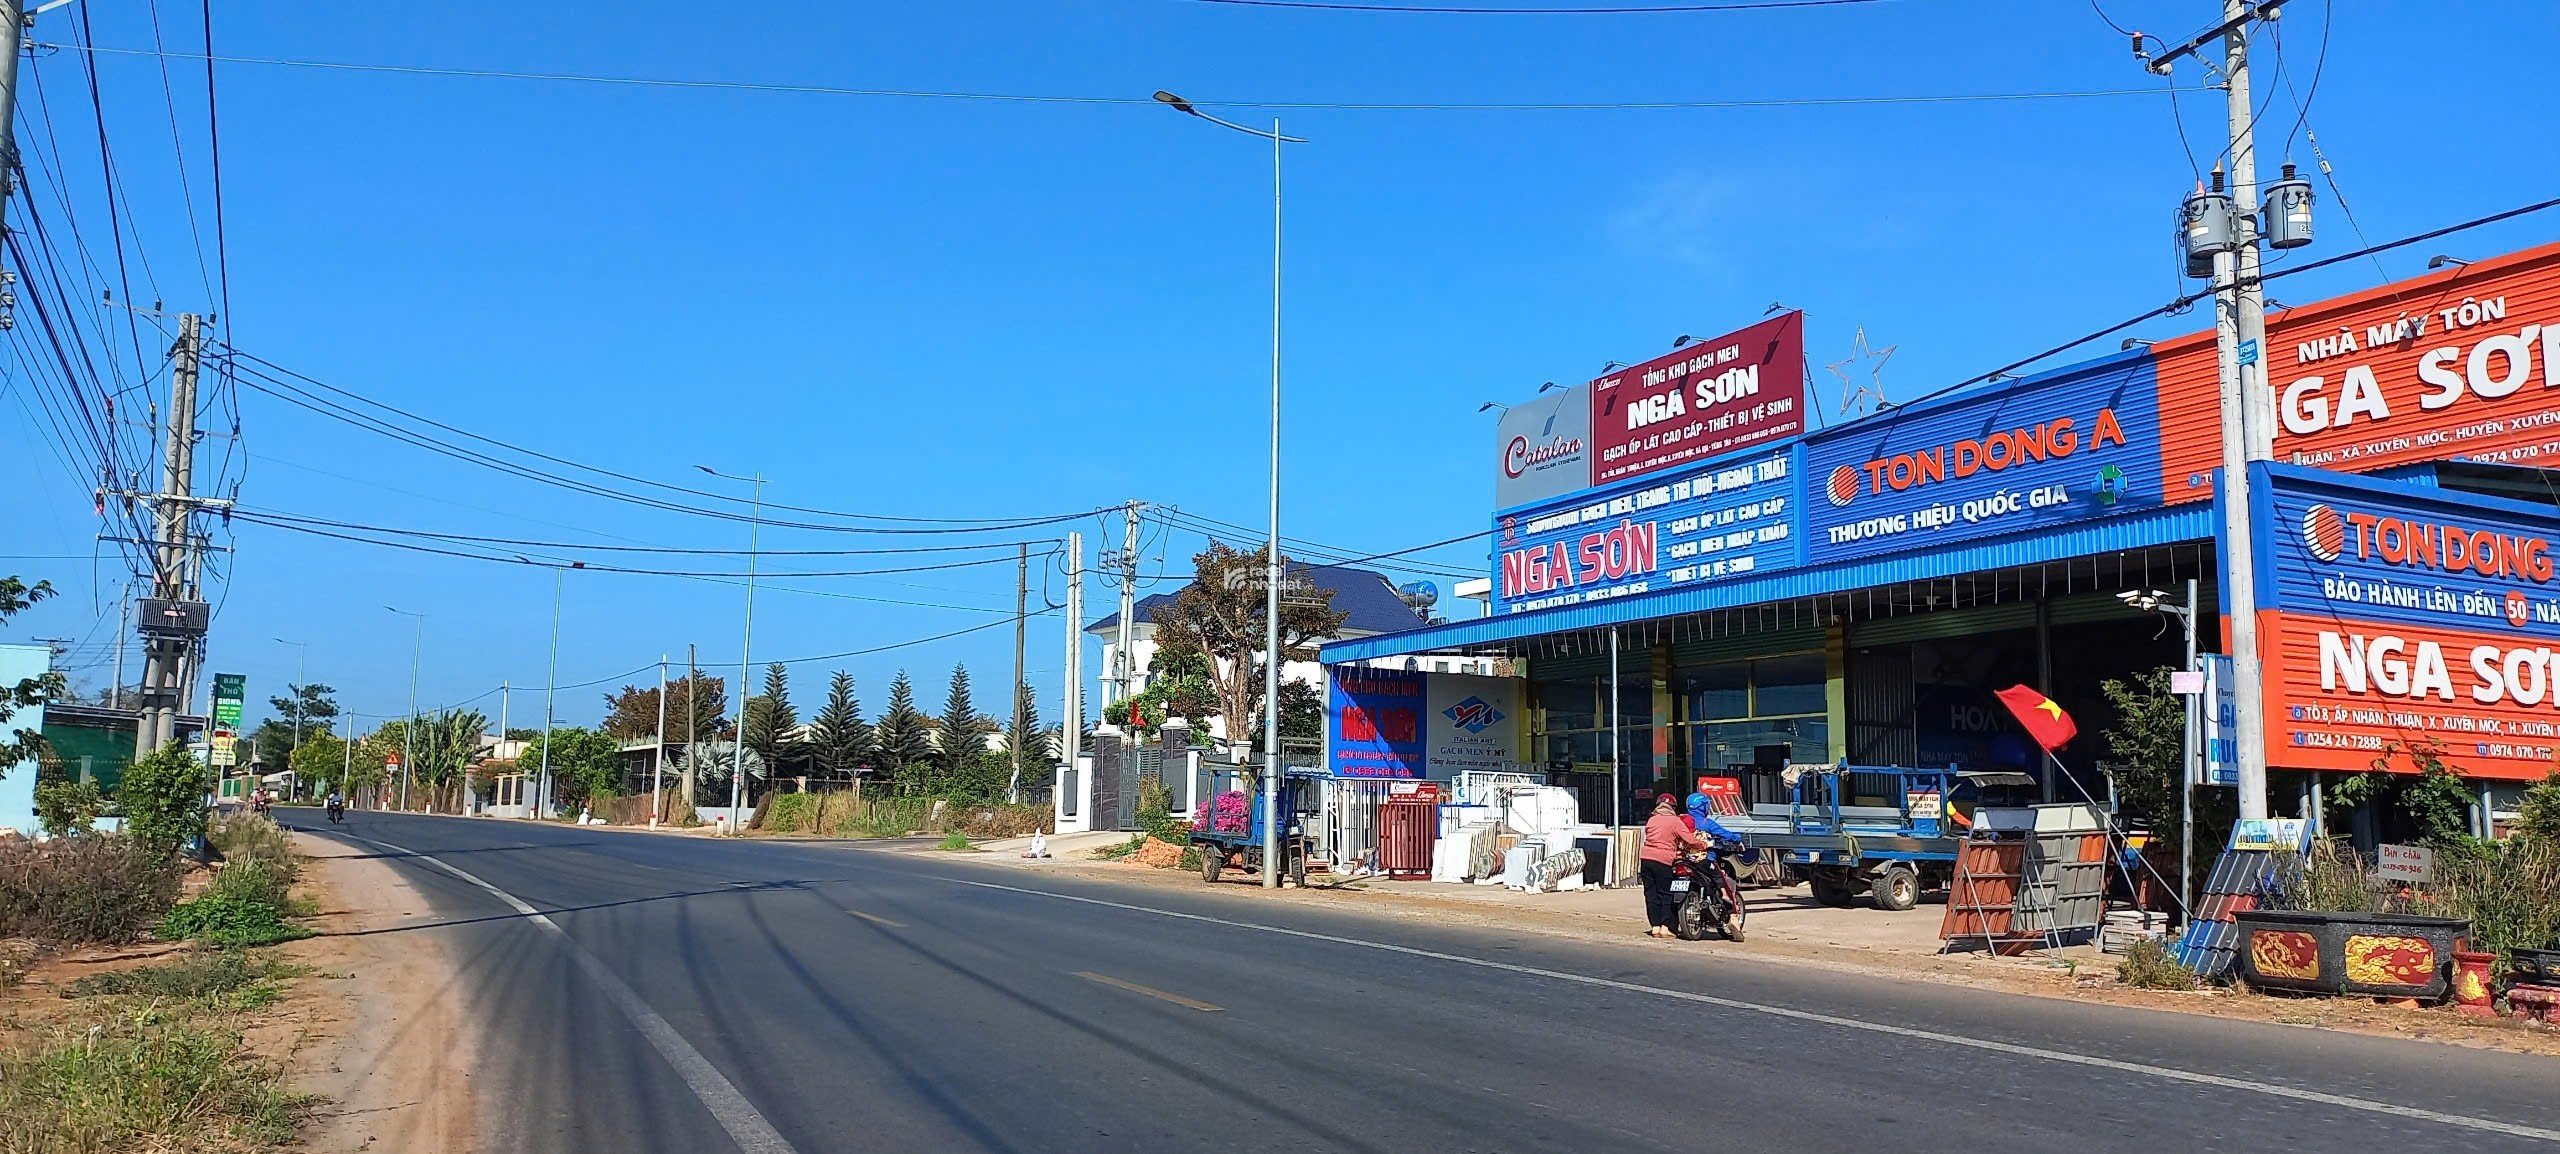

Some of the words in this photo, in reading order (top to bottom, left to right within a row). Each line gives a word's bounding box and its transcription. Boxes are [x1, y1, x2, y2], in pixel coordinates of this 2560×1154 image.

[2298, 326, 2358, 363] NHÀ
[2367, 312, 2428, 348] MÁY
[2439, 296, 2506, 331] TÔN
[1642, 366, 1666, 389] TỔNG
[1668, 361, 1687, 381] KHO
[1689, 351, 1714, 373] GẠCH
[1717, 343, 1739, 365] MEN
[1627, 388, 1686, 431] NGA
[1695, 363, 1759, 410] SƠN
[1603, 443, 1627, 463] GẠCH
[1628, 437, 1642, 456] ỐP
[1643, 433, 1660, 452] LÁT
[1662, 428, 1681, 445] CAO
[1738, 410, 1749, 426] BỊ
[1751, 402, 1765, 422] VỆ
[1767, 397, 1793, 416] SINH
[1863, 445, 1945, 495] TON
[1954, 417, 2079, 479] DONG
[2089, 407, 2127, 450] A
[2341, 444, 2360, 459] XÃ
[2365, 437, 2410, 455] XUYÊN
[2416, 430, 2454, 447] MỘC,
[2456, 420, 2504, 438] HUYỆN
[2511, 410, 2560, 430] XUYÊN
[2512, 446, 2539, 459] 070
[1504, 435, 1583, 479] Catalan
[1738, 503, 1759, 520] CAO
[1828, 514, 1906, 544] THƯƠNG
[1912, 503, 1956, 533] HIỆU
[1963, 487, 2022, 523] QUỐC
[2029, 485, 2069, 508] GIA
[1502, 540, 1575, 599] NGA
[1578, 518, 1657, 585] SƠN
[1701, 536, 1723, 554] MEN
[2346, 512, 2436, 568] TON
[2441, 525, 2553, 582] DONG
[2323, 573, 2361, 602] BẢO
[2367, 579, 2420, 610] HÀNH
[2426, 586, 2458, 613] LÊN
[2463, 589, 2497, 617] ĐẾN
[2508, 598, 2527, 620] 50
[2318, 630, 2456, 701] NGA
[2305, 700, 2320, 720] TỔ
[2334, 704, 2348, 723] ẤP
[2352, 708, 2384, 724] NHÂN
[2387, 711, 2425, 732] THUẬN,
[2428, 716, 2440, 730] X.
[2443, 715, 2475, 732] XUYÊN
[2479, 717, 2505, 737] MỘC,
[2508, 721, 2520, 736] H.
[2521, 720, 2554, 737] XUYÊN
[2307, 733, 2332, 747] 0254
[2335, 734, 2348, 748] 24
[1466, 747, 1483, 756] MEN
[2490, 744, 2513, 758] 0974
[2516, 746, 2533, 759] 070
